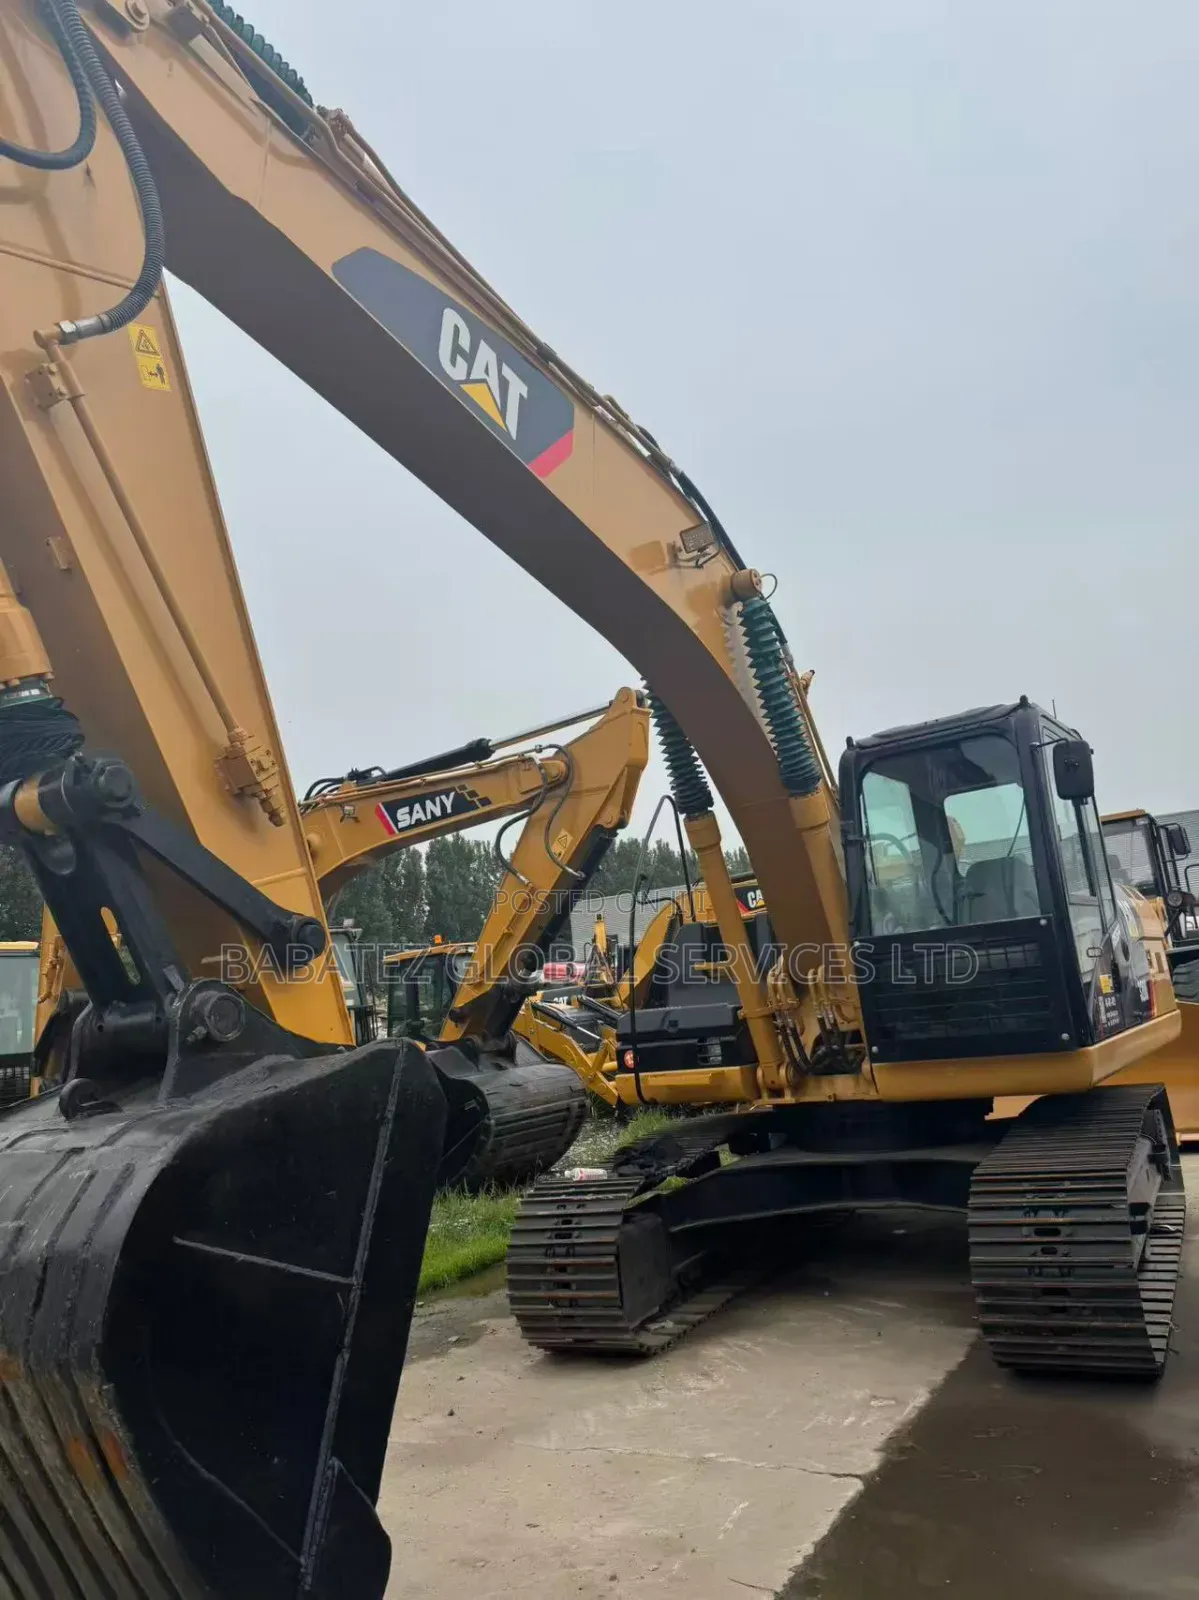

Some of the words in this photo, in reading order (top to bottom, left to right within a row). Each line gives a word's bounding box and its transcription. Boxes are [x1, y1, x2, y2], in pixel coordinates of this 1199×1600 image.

[438, 307, 528, 441] CAT
[396, 791, 456, 829] SANY
[747, 889, 764, 908] CA
